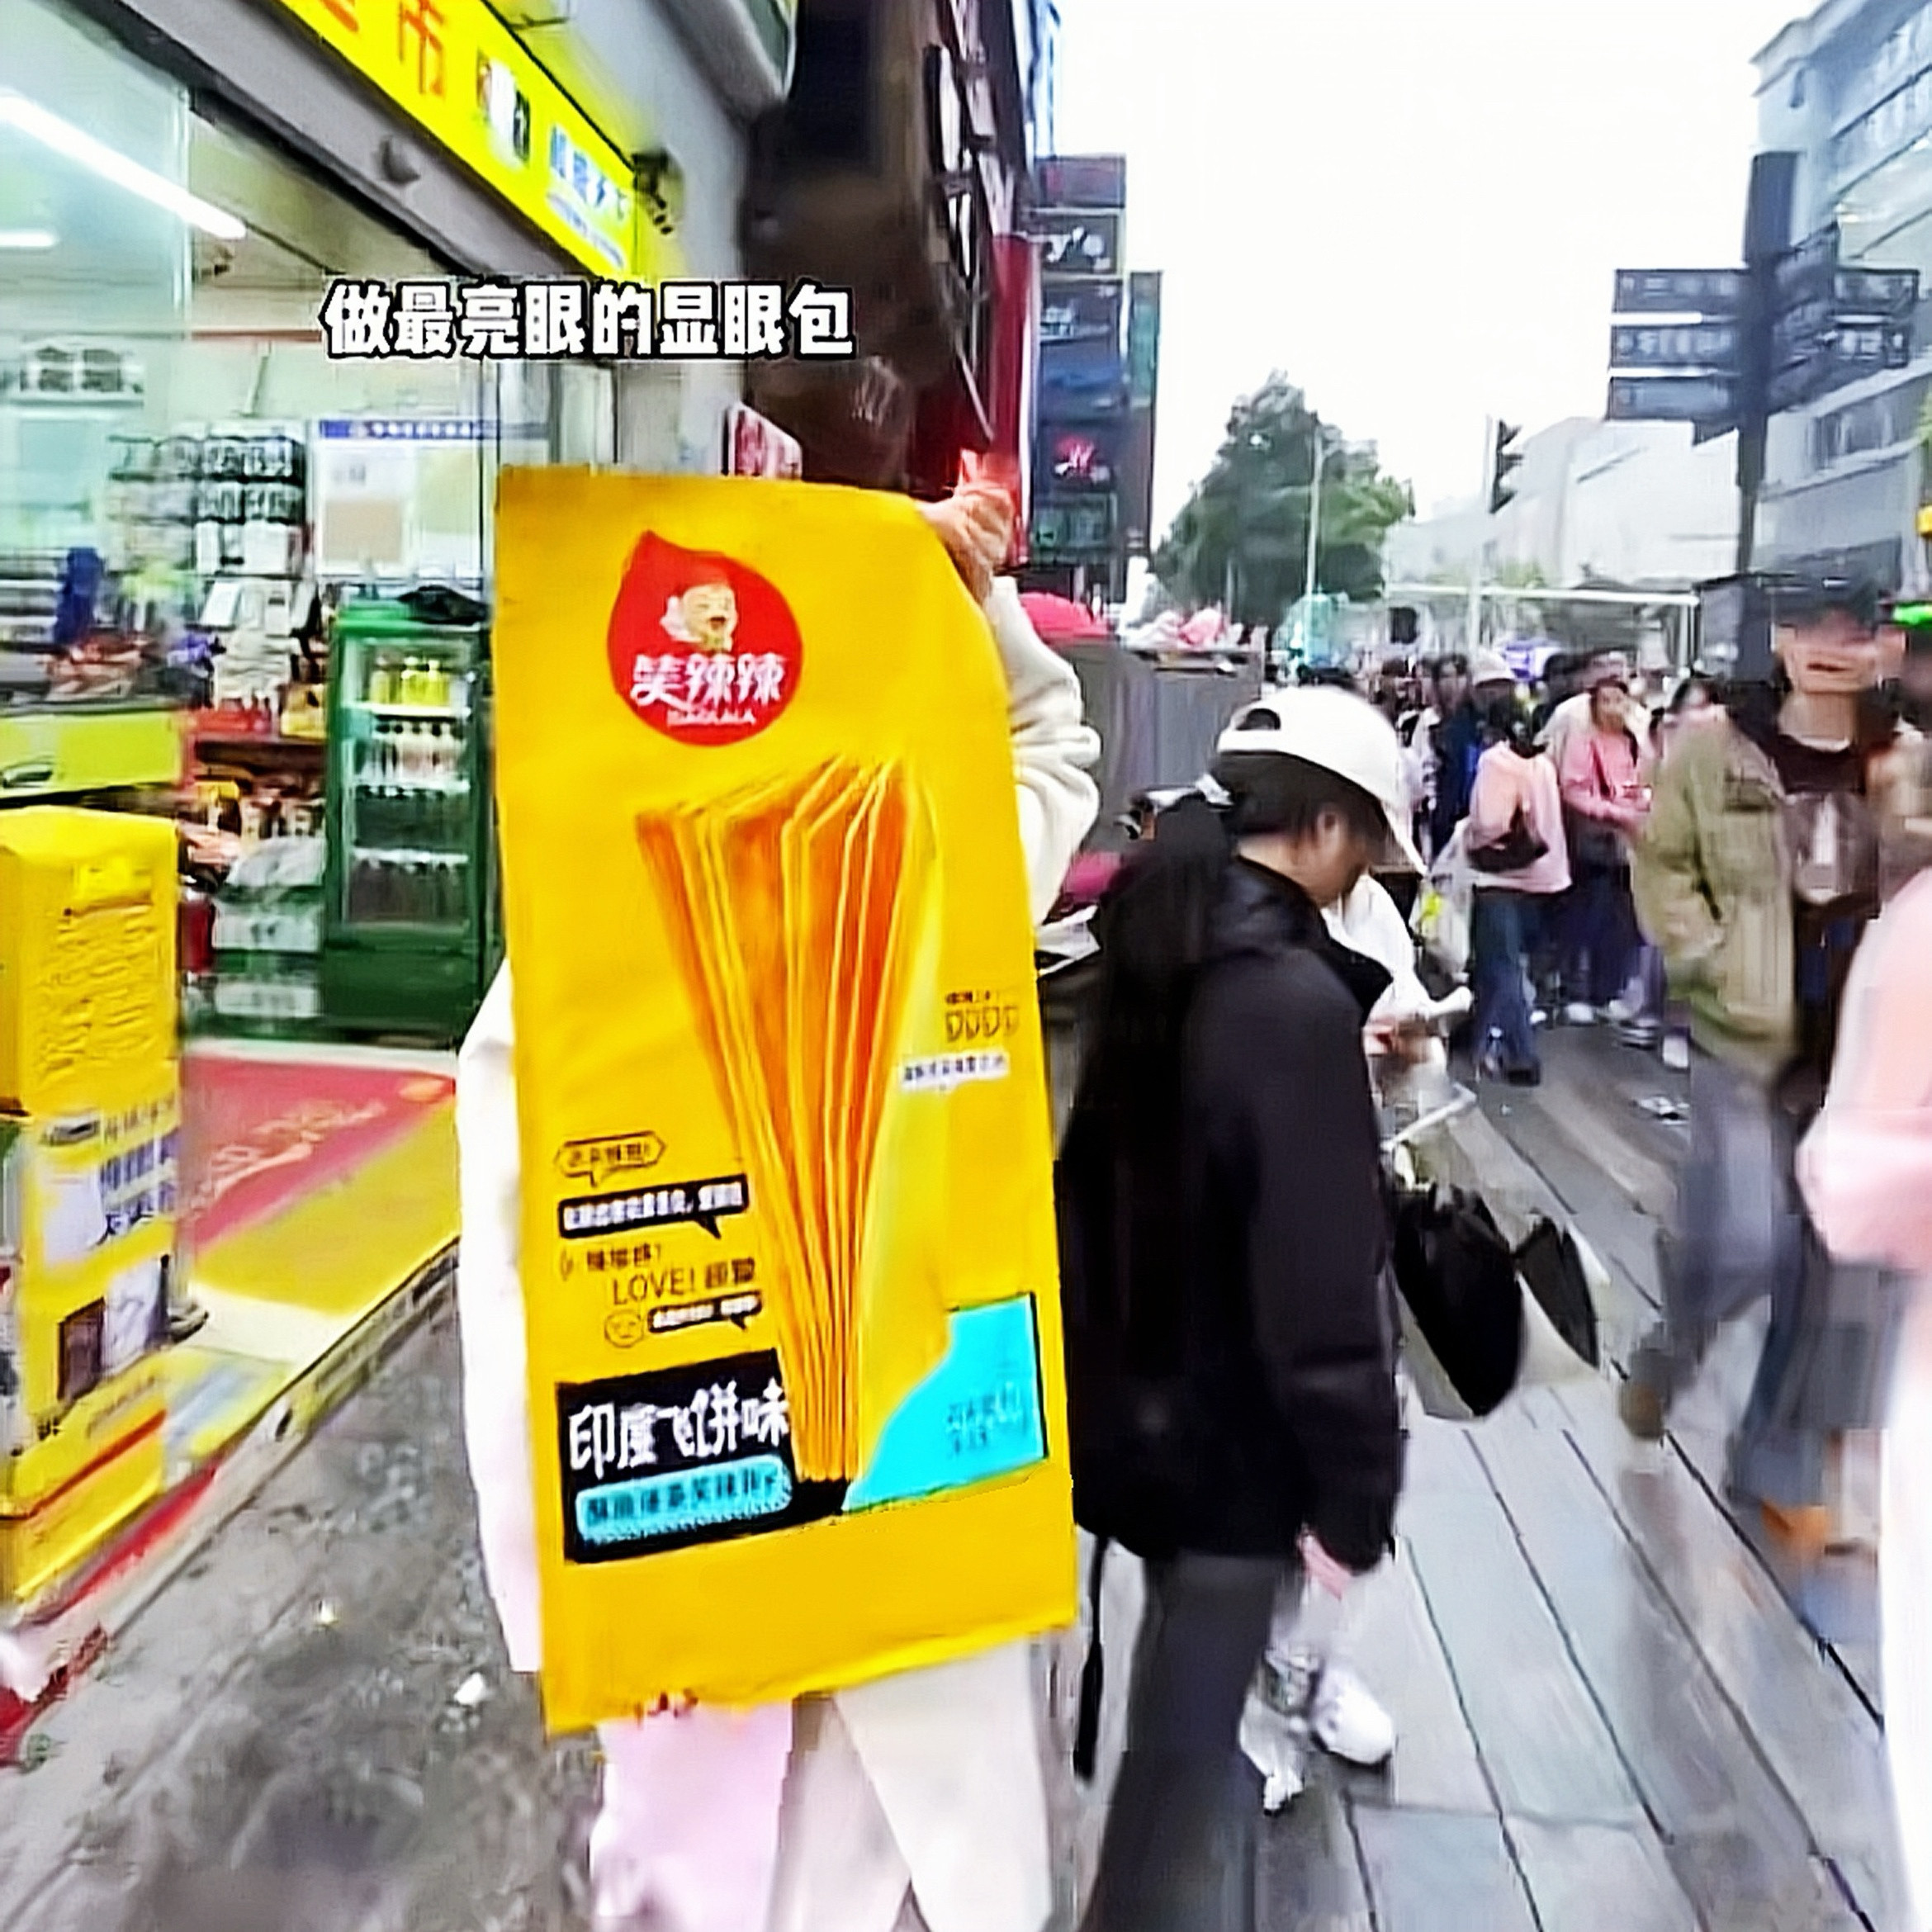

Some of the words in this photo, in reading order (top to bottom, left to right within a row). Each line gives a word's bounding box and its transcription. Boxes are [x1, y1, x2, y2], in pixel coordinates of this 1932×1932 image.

[630, 651, 787, 713] 笑辣辣
[569, 1376, 790, 1480] 印度飞饼味
